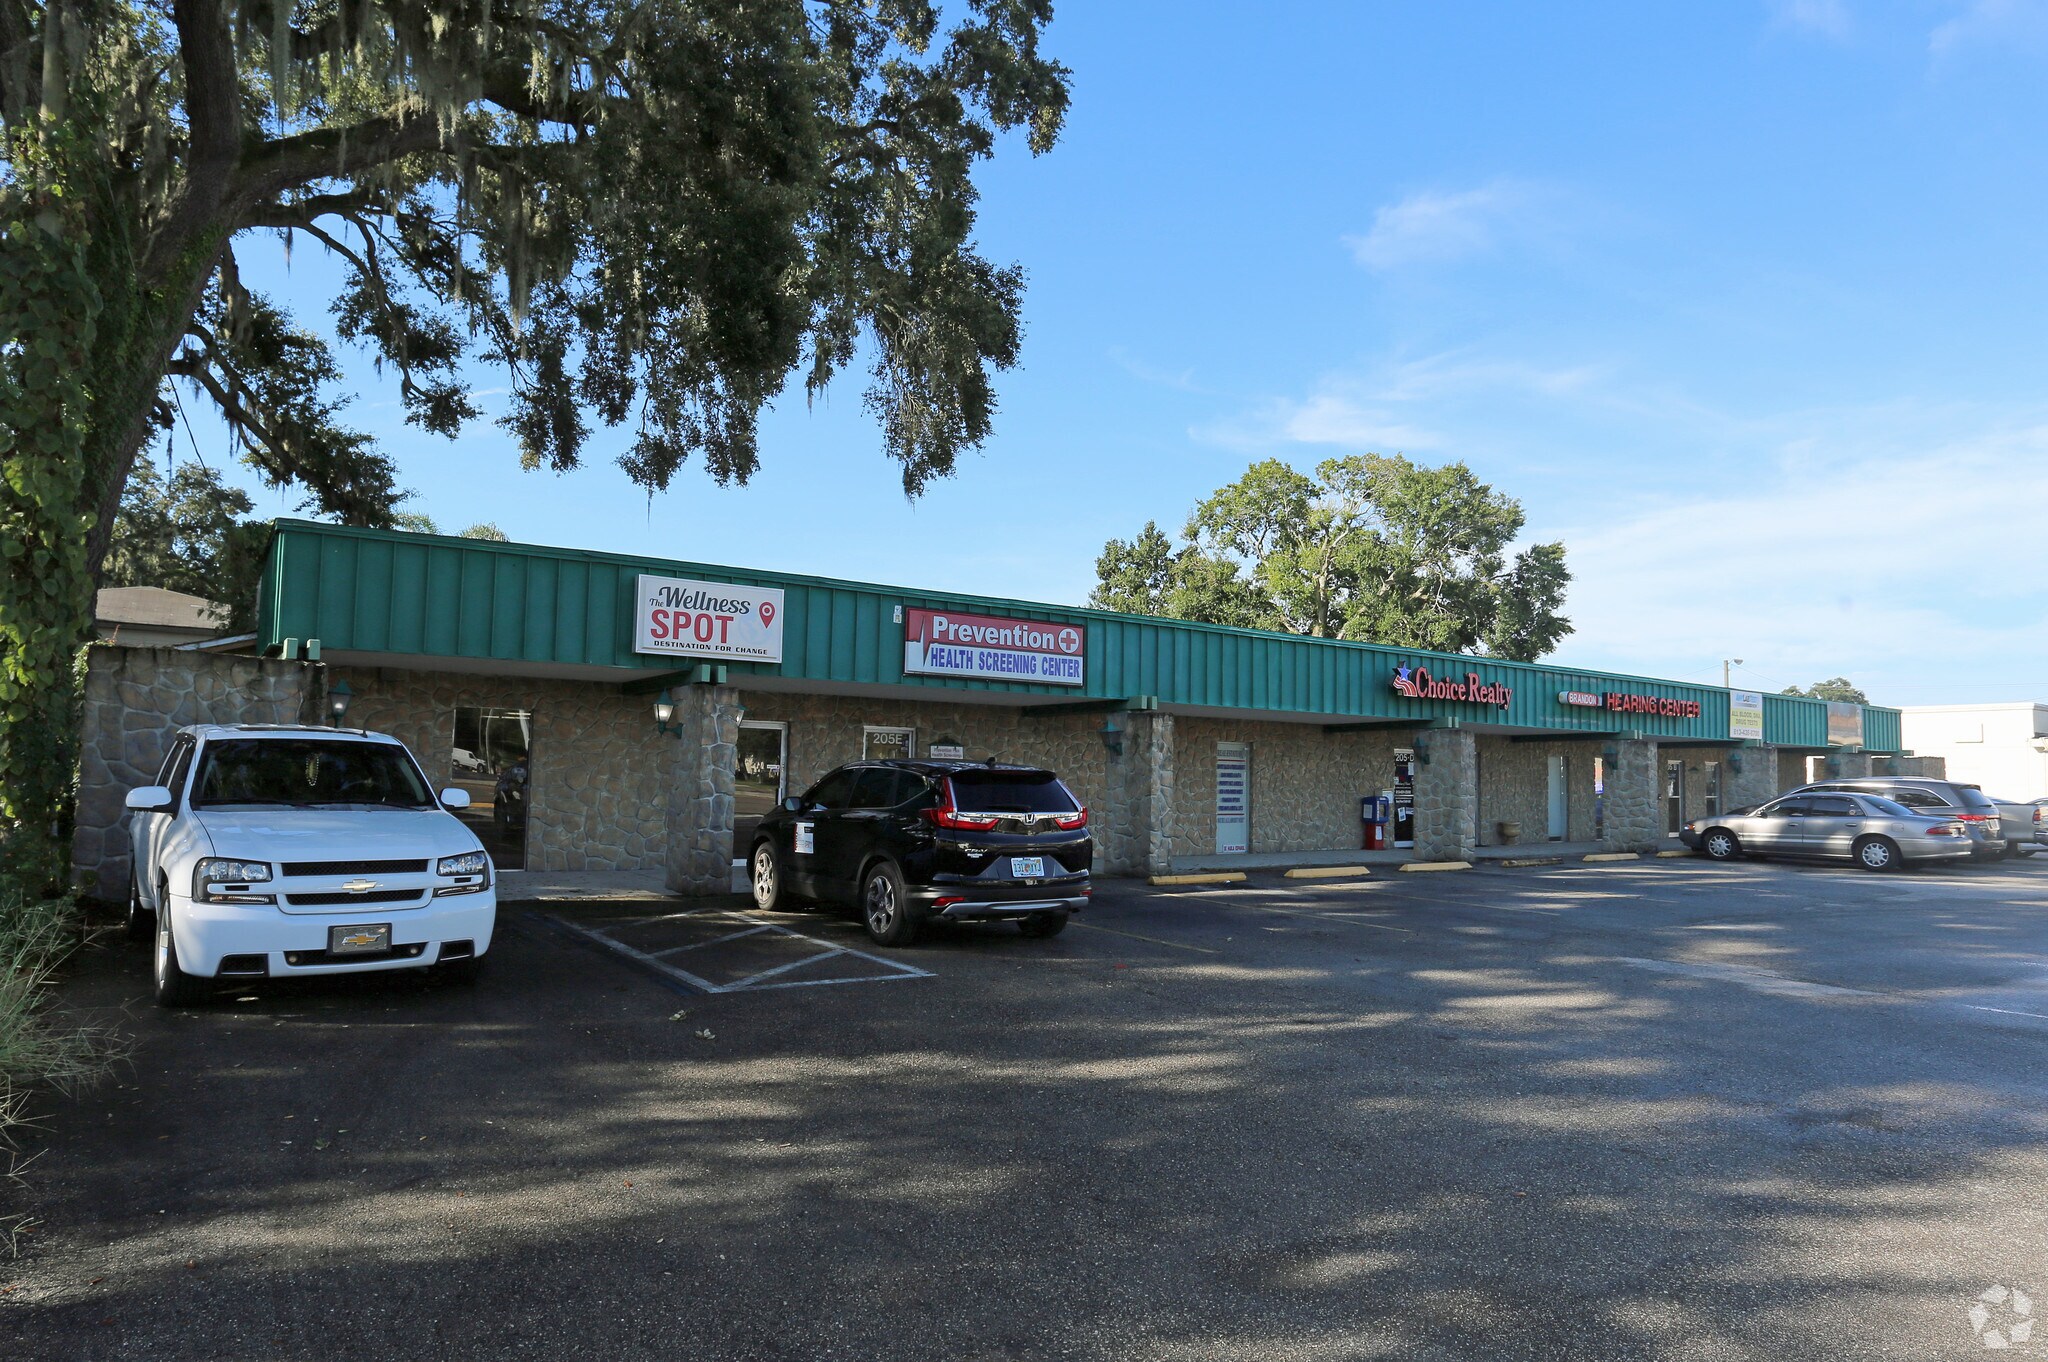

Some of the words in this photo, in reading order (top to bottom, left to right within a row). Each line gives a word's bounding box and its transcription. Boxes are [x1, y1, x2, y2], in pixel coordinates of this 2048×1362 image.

[650, 598, 664, 607] The
[659, 587, 751, 614] Wellness
[651, 609, 734, 643] SPOT
[932, 616, 1055, 650] Prevention
[654, 640, 711, 650] DESTINATION
[735, 646, 768, 655] CHANGE
[930, 647, 974, 670] HEALTH
[978, 651, 1037, 674] SCREENING
[1041, 656, 1080, 678] CENTER
[1416, 667, 1467, 700] Choice
[1468, 673, 1513, 710] Realty
[1569, 691, 1597, 706] BRANDON
[1606, 692, 1656, 714] HEARING
[1659, 699, 1701, 718] CENTER
[873, 733, 903, 745] 205E
